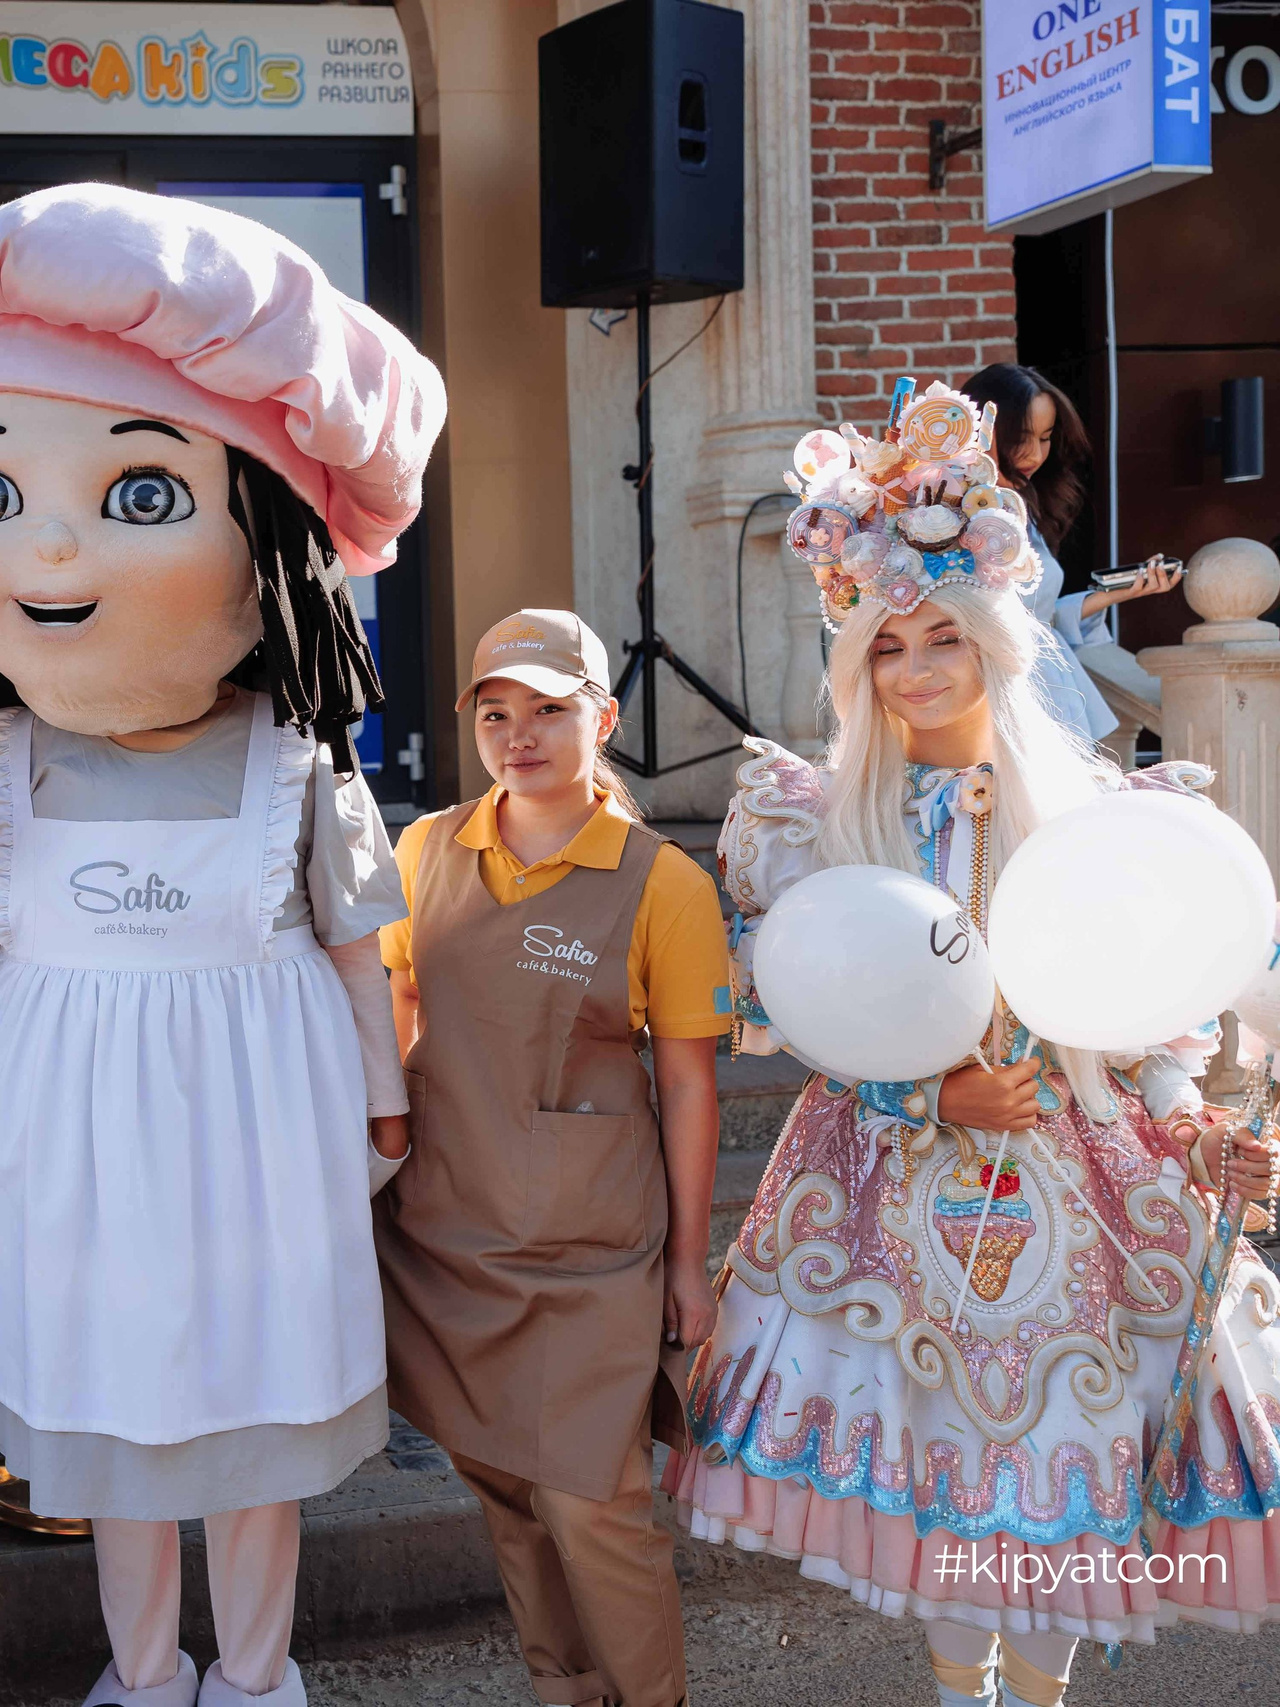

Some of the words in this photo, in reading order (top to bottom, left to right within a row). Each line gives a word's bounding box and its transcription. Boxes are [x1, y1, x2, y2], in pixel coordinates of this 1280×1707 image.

[326, 38, 398, 56] ШКОЛА
[995, 7, 1140, 101] ENGLISH
[322, 61, 404, 80] РАННЕГО
[1098, 59, 1132, 82] ЦЕНТР
[1165, 0, 1200, 124] БАТ
[319, 85, 410, 104] РАЗВИТИЯ
[1013, 98, 1086, 137] АНГЛИЙСКОГО
[1087, 81, 1123, 105] ЯЗЫКА
[495, 622, 547, 643] Safia
[516, 641, 545, 651] bakery
[70, 860, 191, 915] Safia
[523, 924, 598, 965] Safia
